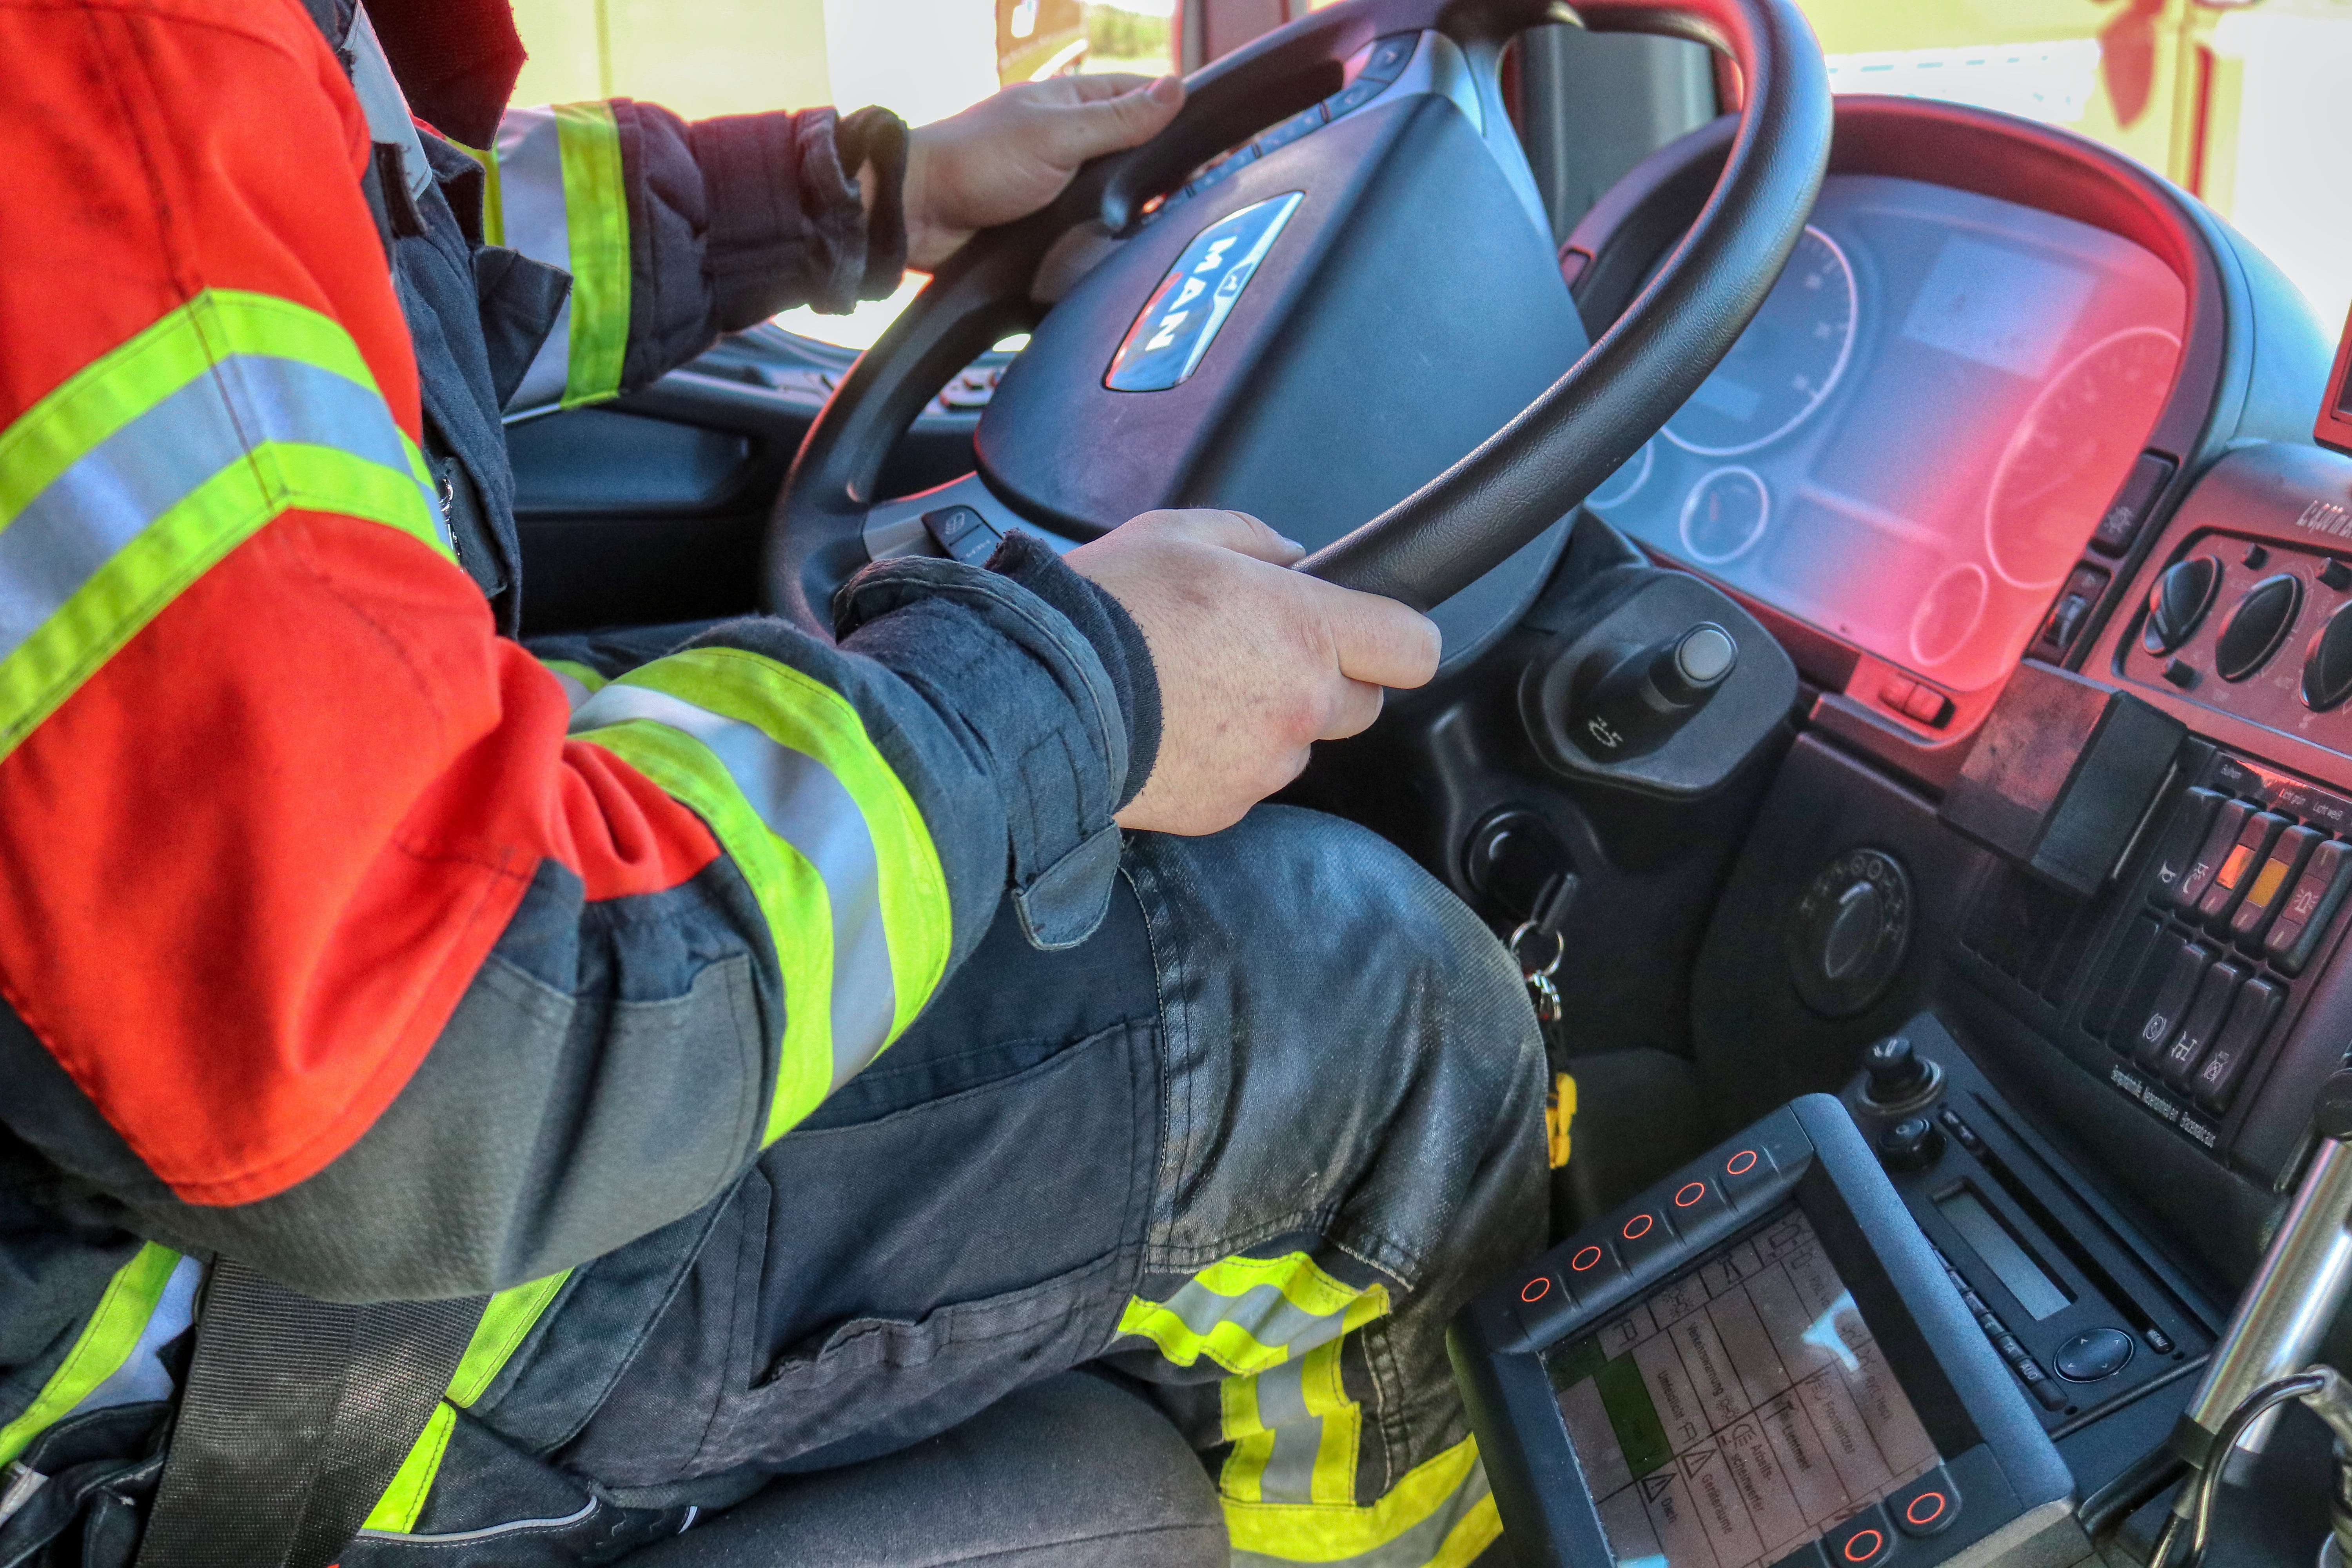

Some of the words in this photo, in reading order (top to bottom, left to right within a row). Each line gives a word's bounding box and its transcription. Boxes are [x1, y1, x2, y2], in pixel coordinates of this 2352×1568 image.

[1144, 235, 1237, 352] MAN
[1687, 1322, 1724, 1397] Verkehrswarnung
[1657, 1370, 1685, 1421] Umfeldlicht
[1750, 1444, 1772, 1481] Arbeits-
[1783, 1425, 1810, 1471] Lichtmast
[1701, 1474, 1732, 1534] Geräteräume
[1731, 1453, 1763, 1511] scheinwerfer
[1661, 1497, 1678, 1524] Dach
